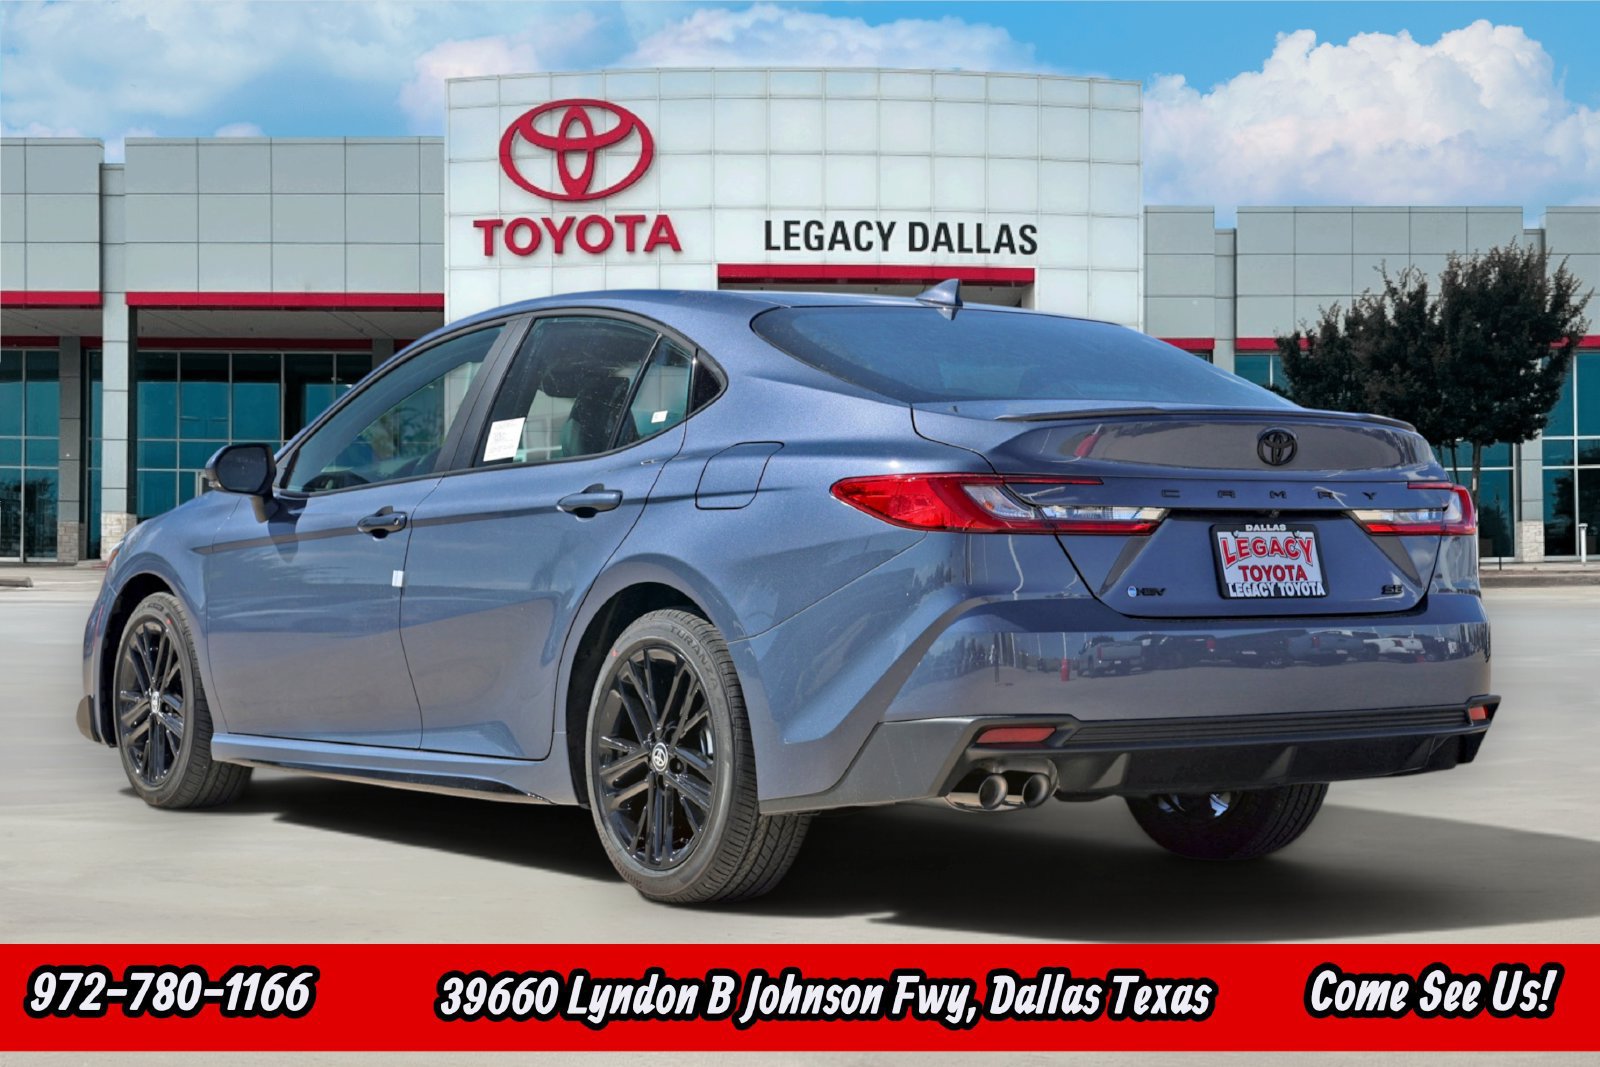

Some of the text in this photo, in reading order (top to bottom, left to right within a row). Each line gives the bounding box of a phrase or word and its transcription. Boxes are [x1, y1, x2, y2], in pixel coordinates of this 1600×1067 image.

[473, 214, 682, 257] TOYOTA
[764, 220, 1038, 255] LEGACY DALLAS
[1161, 489, 1377, 500] CAMRY
[1219, 537, 1313, 569] LEGACY
[1238, 565, 1308, 582] TOYOTA
[1228, 581, 1326, 597] LEGACY TOYOTA
